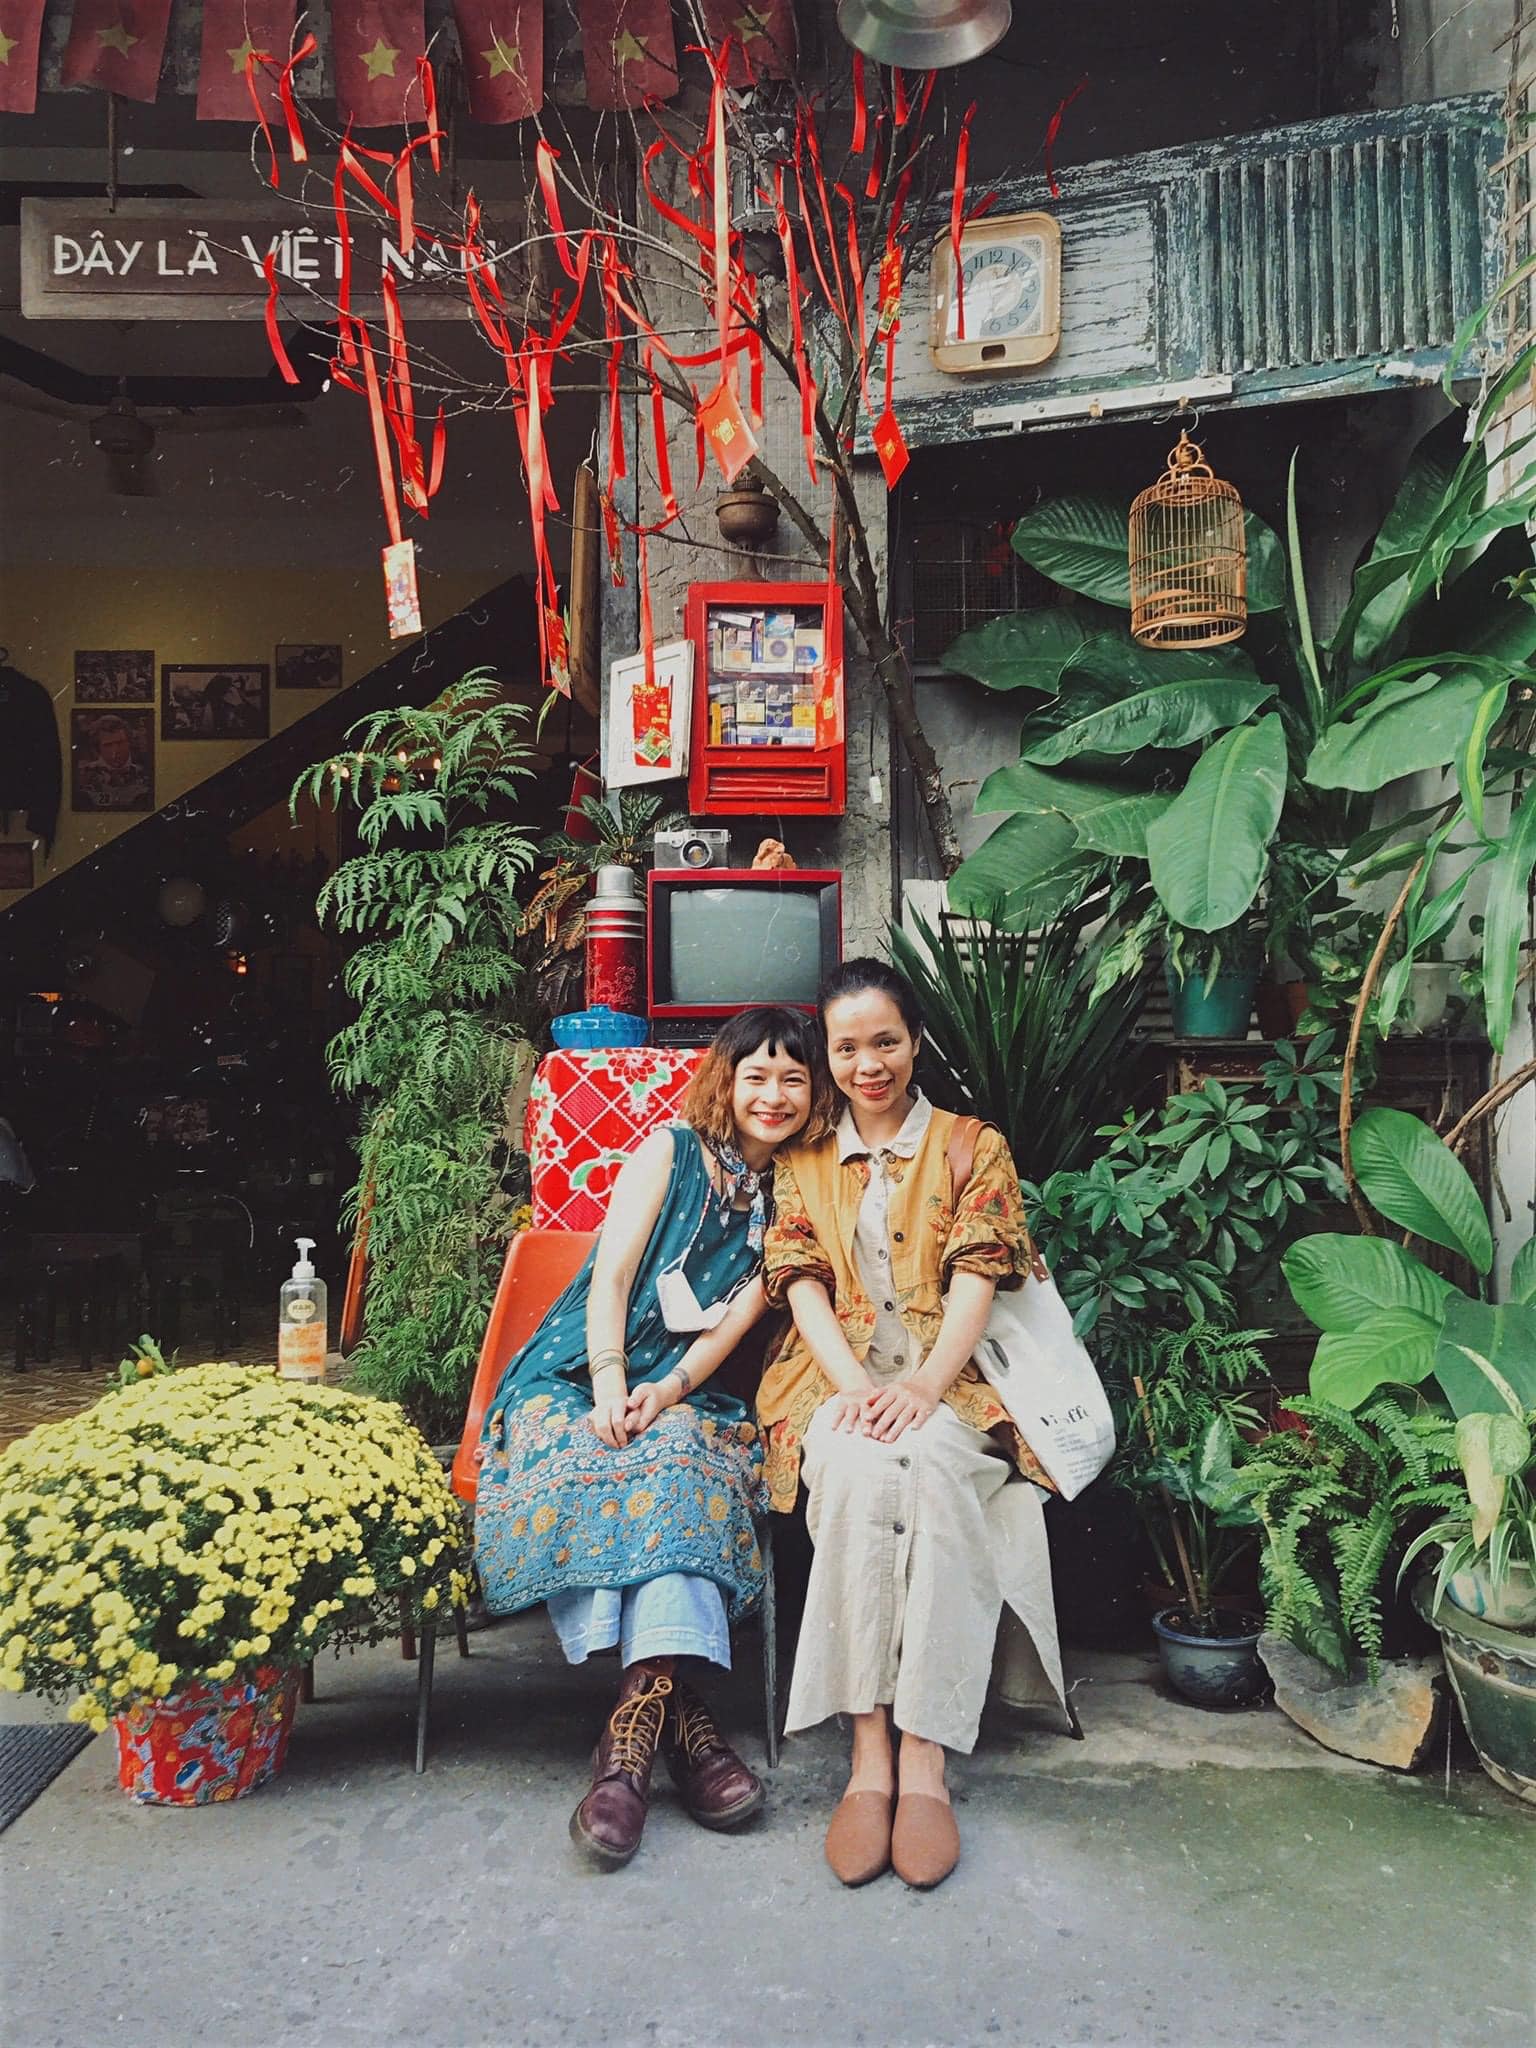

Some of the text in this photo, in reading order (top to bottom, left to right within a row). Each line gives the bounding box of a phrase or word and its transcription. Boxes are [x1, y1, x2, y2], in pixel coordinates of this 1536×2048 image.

[54, 230, 144, 276] ĐÂY
[241, 227, 354, 288] VIỆT
[974, 256, 984, 269] 11
[989, 250, 1003, 264] 12
[1025, 279, 1037, 293] 3
[1019, 298, 1031, 311] 4
[990, 318, 1001, 331] 6
[1007, 312, 1020, 327] 5
